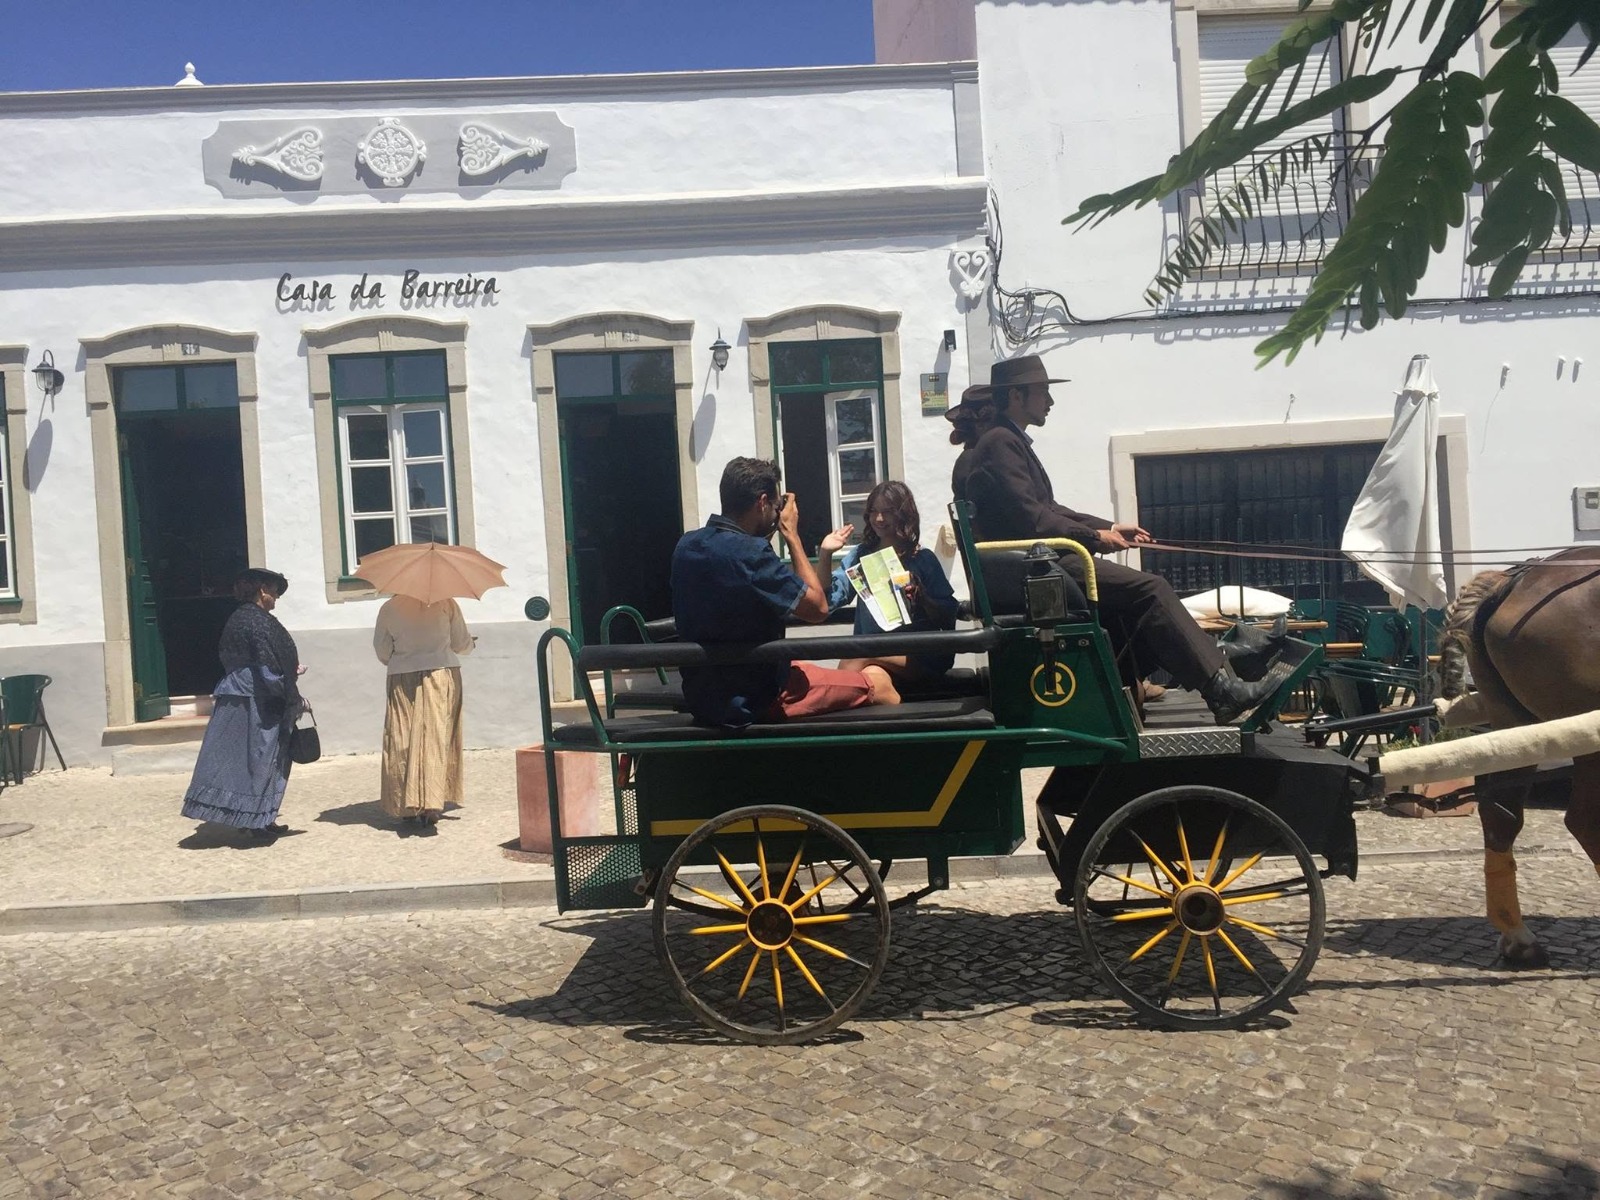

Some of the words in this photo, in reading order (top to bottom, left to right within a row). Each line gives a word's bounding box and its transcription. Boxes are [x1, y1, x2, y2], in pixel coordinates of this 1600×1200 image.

[276, 272, 336, 301] Casa
[350, 272, 385, 299] da
[401, 268, 500, 299] Barreira
